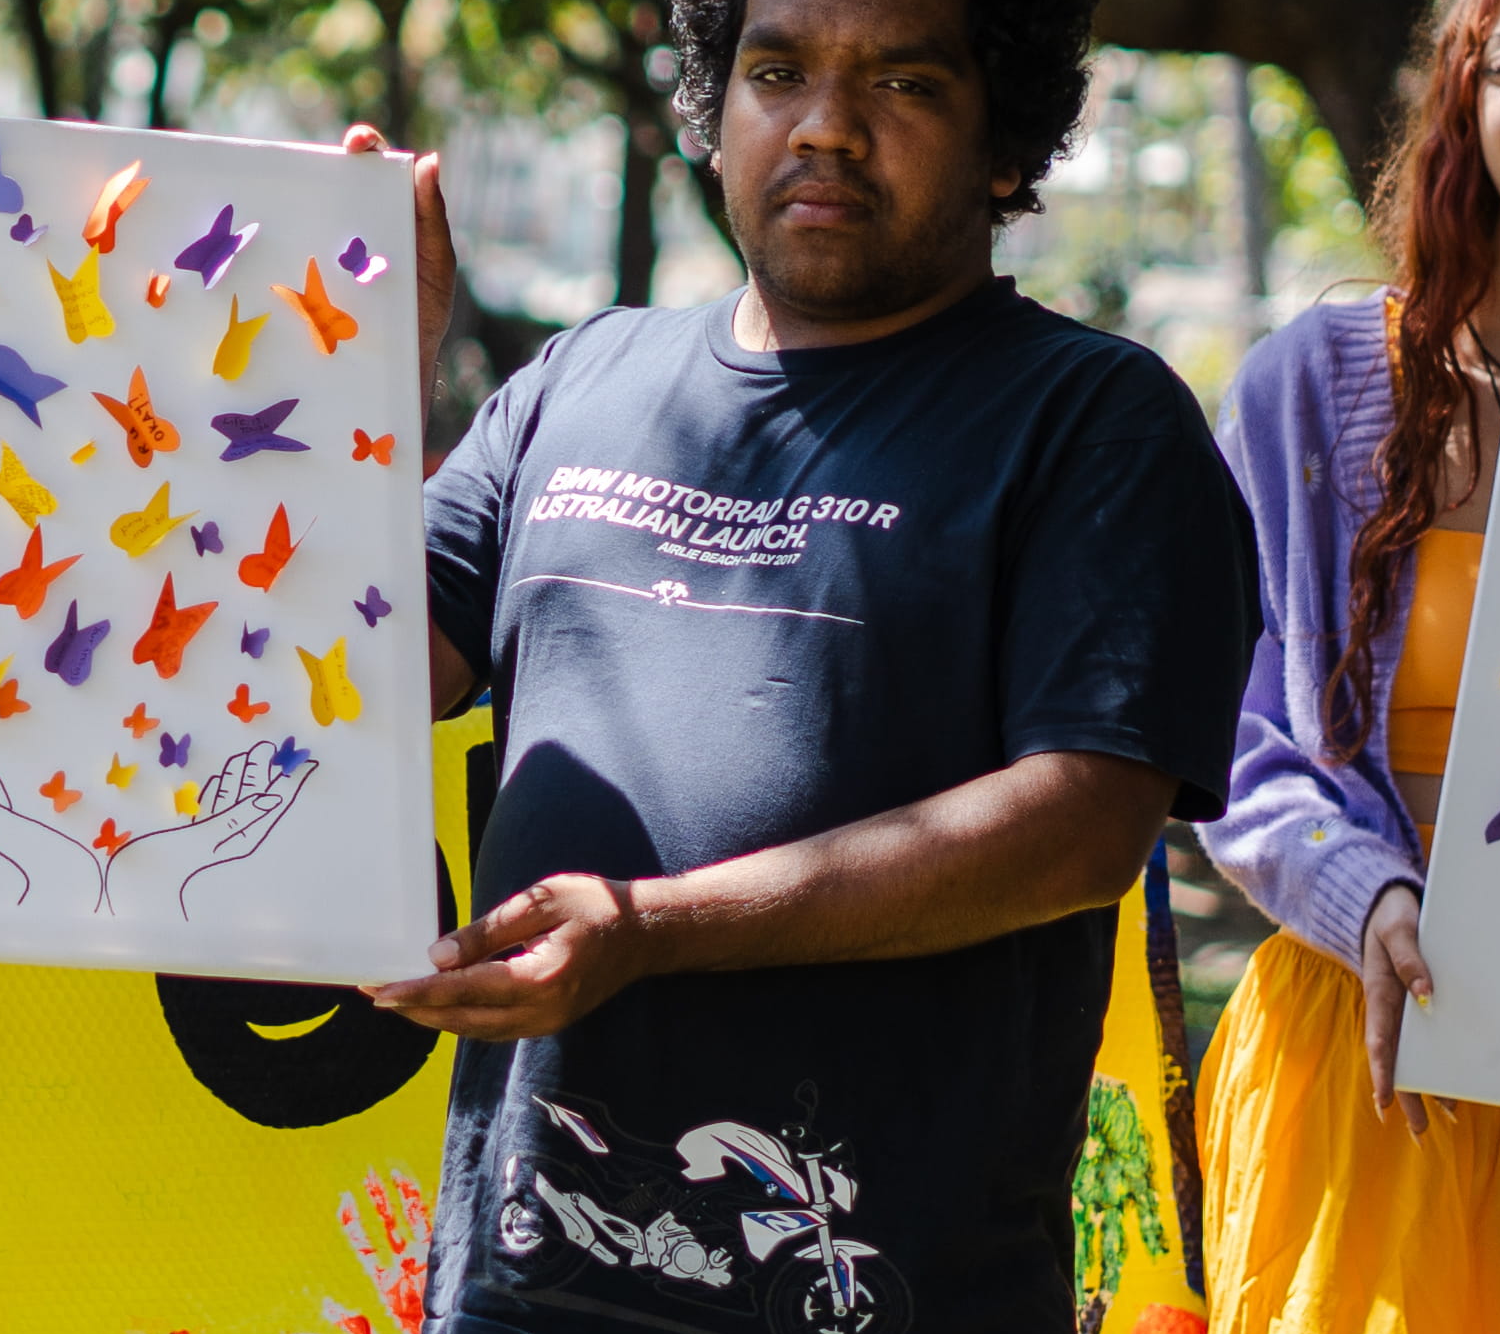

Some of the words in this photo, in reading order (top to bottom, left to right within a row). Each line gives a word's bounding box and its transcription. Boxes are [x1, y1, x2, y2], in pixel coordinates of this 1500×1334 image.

[546, 466, 622, 493] BMW
[614, 472, 784, 524] MOTORRAD
[786, 495, 812, 521] G
[811, 495, 871, 523] 310
[868, 503, 900, 529] R
[688, 521, 809, 551] LAUNCH.
[656, 541, 701, 560] AIRLIE
[774, 552, 802, 565] 2017
